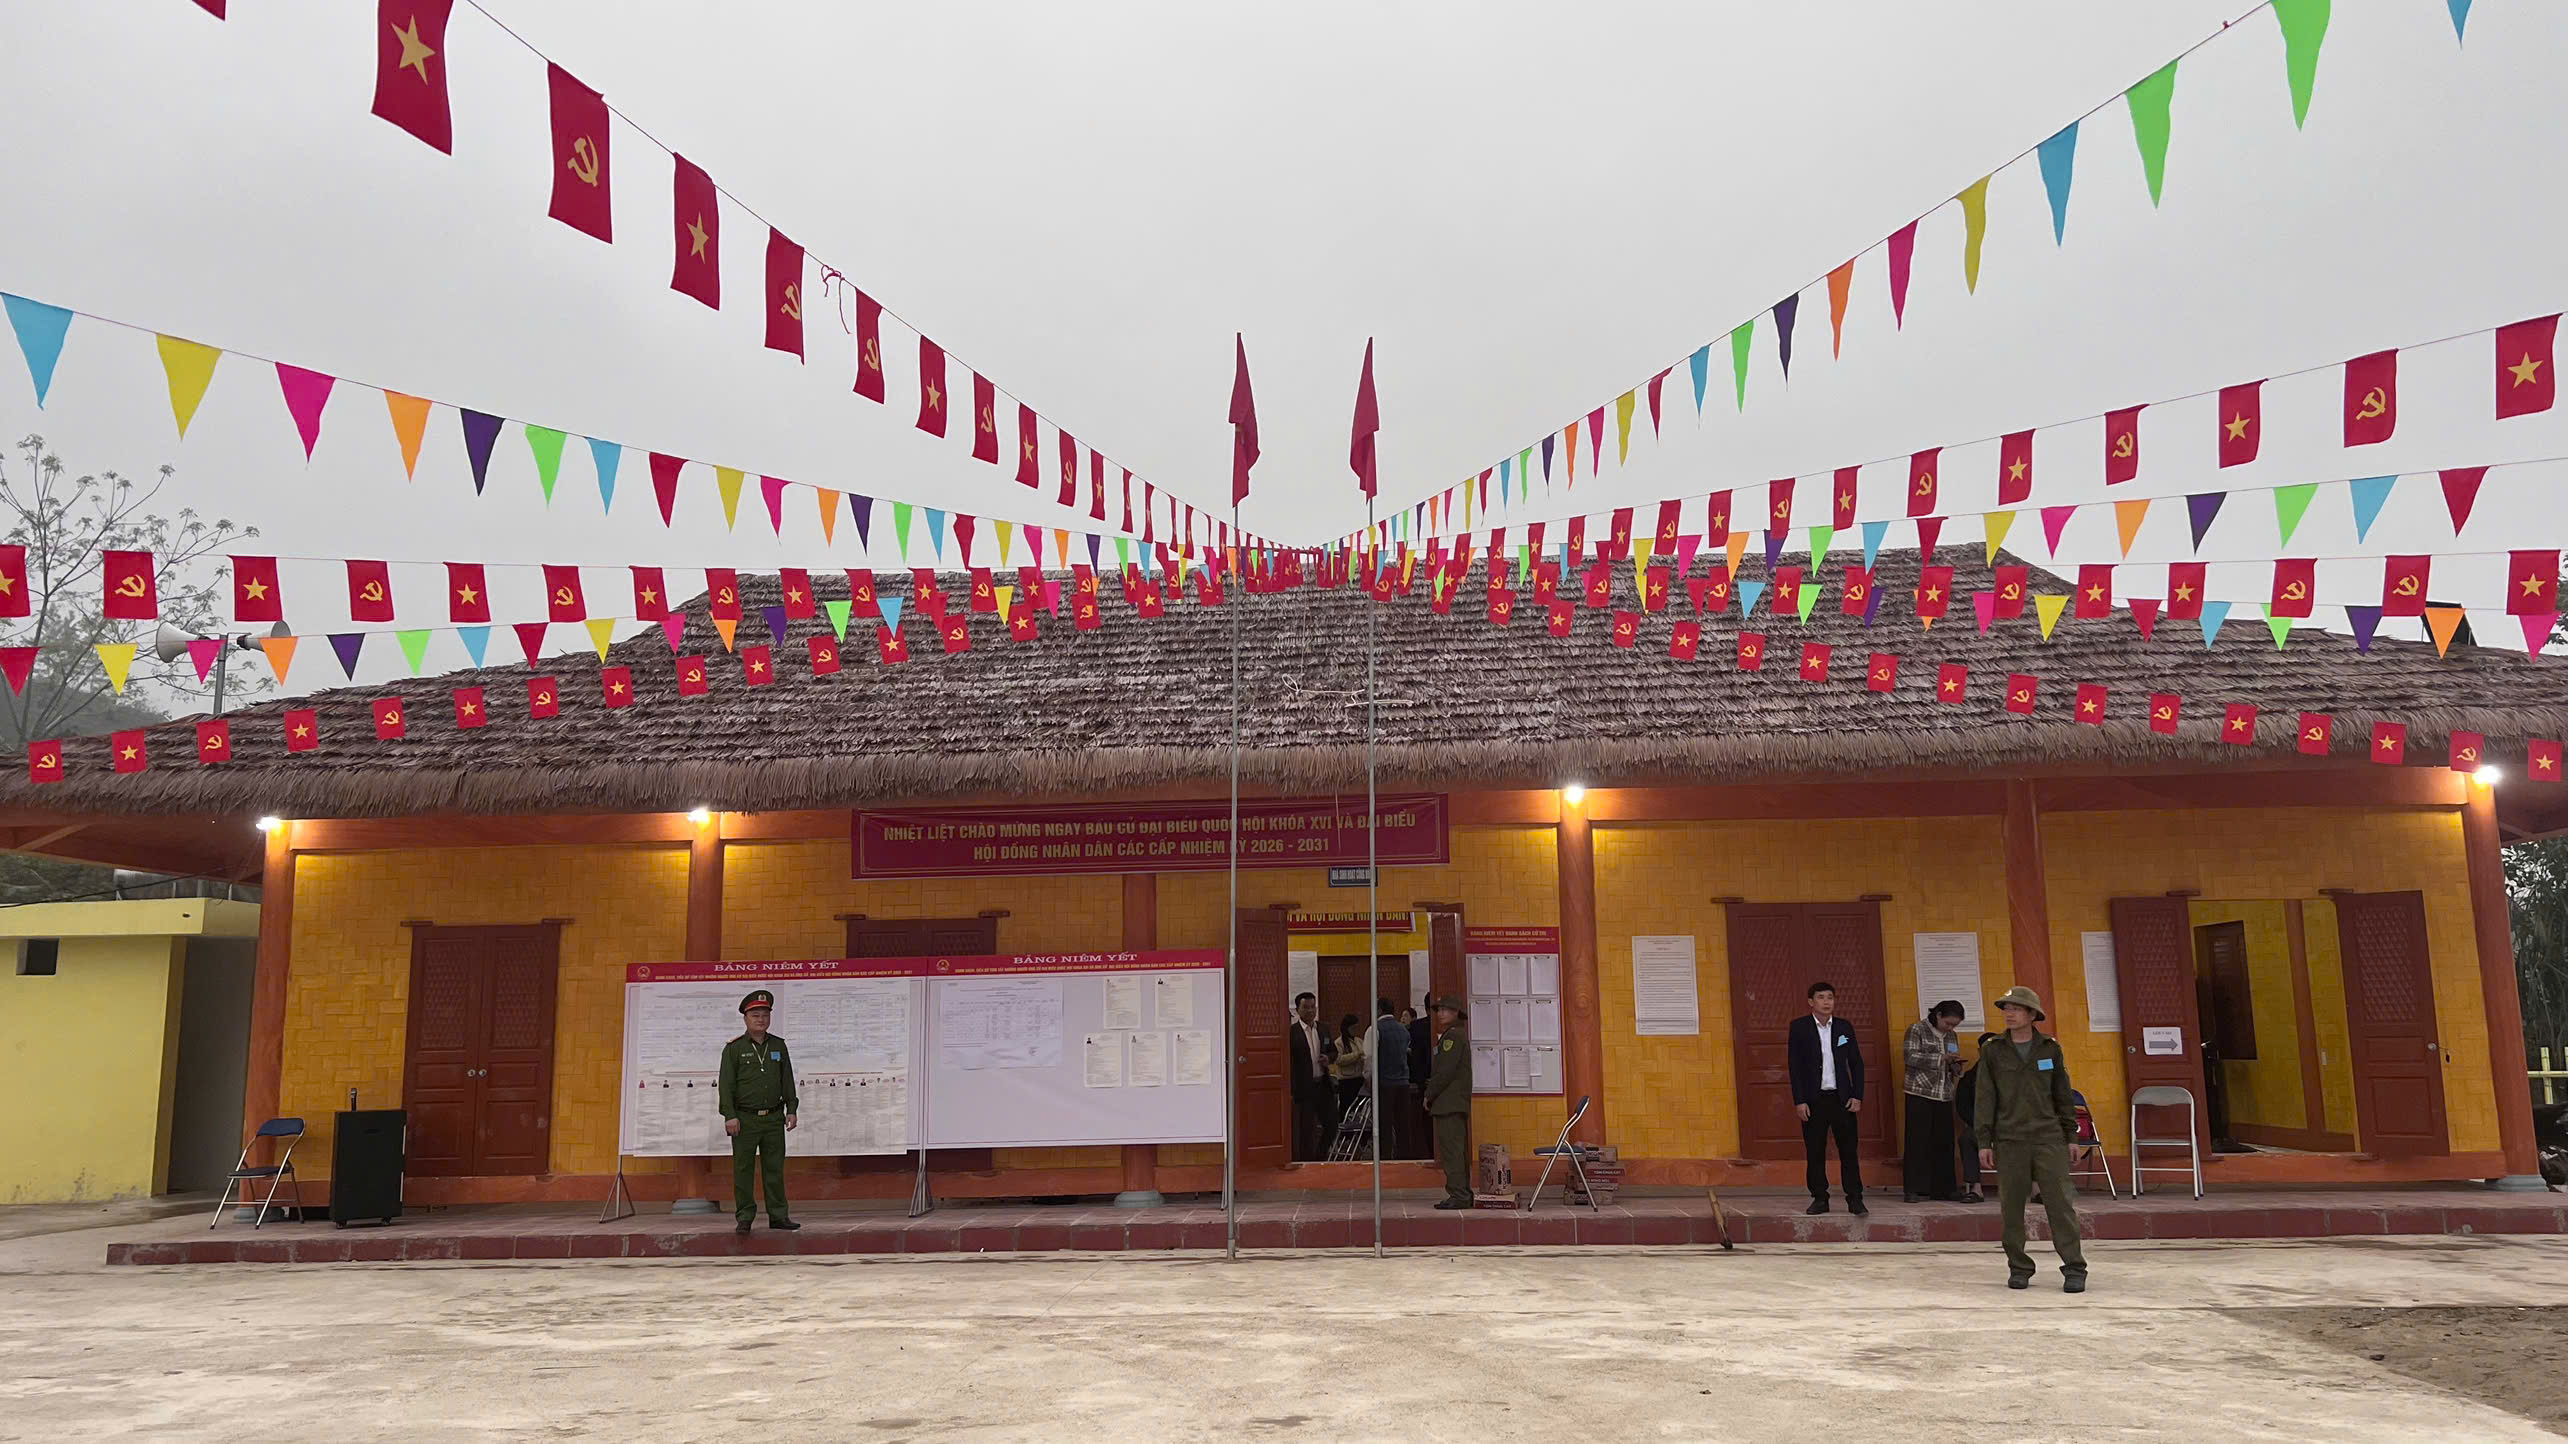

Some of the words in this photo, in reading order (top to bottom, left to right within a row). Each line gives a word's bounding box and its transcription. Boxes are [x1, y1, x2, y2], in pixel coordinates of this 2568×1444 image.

[884, 824, 925, 843] NHIỆT
[927, 823, 956, 843] LIỆT
[960, 822, 996, 839] CHÀO
[1139, 820, 1162, 837] ĐẠI
[1242, 815, 1265, 834] HỘI
[1269, 814, 1306, 831] KHÓA
[1310, 815, 1332, 830] XVI
[1384, 808, 1416, 828] BIỂU
[974, 844, 997, 863] HỘI
[1000, 841, 1039, 860] ĐỒNG
[1042, 841, 1081, 859] NHÂN
[1085, 840, 1113, 857] DÂN
[1117, 839, 1145, 856] CÁC
[1149, 836, 1176, 856] CẤP
[1180, 838, 1225, 857] NHIỆM
[1251, 839, 1284, 853] 2026
[1297, 837, 1329, 852] 2031
[762, 961, 804, 971] NIÊM
[807, 959, 839, 969] YẾT
[1061, 953, 1103, 963] NIÊM
[1107, 951, 1138, 962] YẾT
